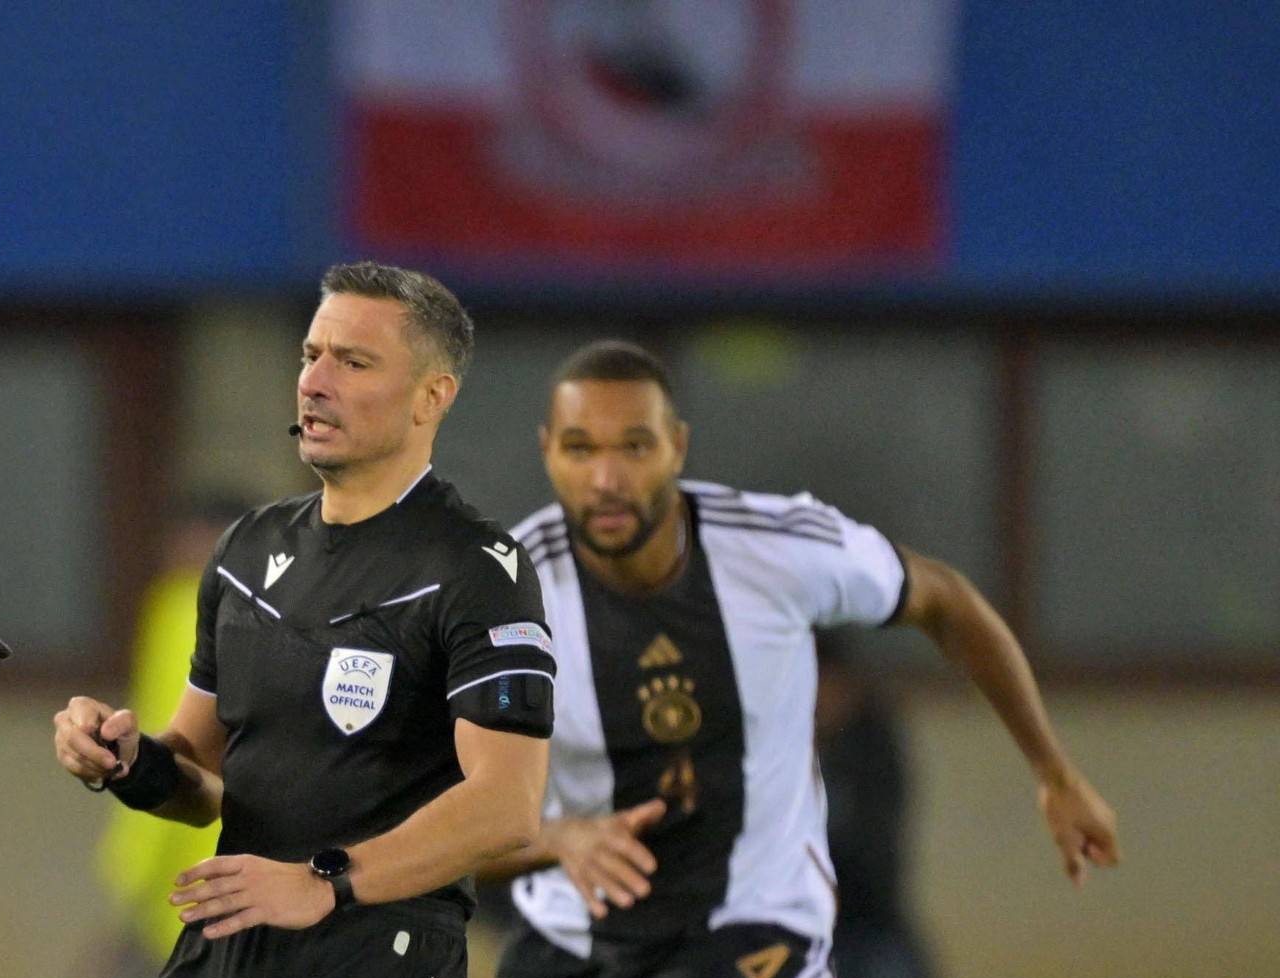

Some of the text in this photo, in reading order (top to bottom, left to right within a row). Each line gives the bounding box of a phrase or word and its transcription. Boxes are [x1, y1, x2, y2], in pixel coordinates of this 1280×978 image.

[340, 658, 377, 677] UEFA
[336, 682, 374, 697] MATCH
[330, 694, 376, 710] OFFICIAL
